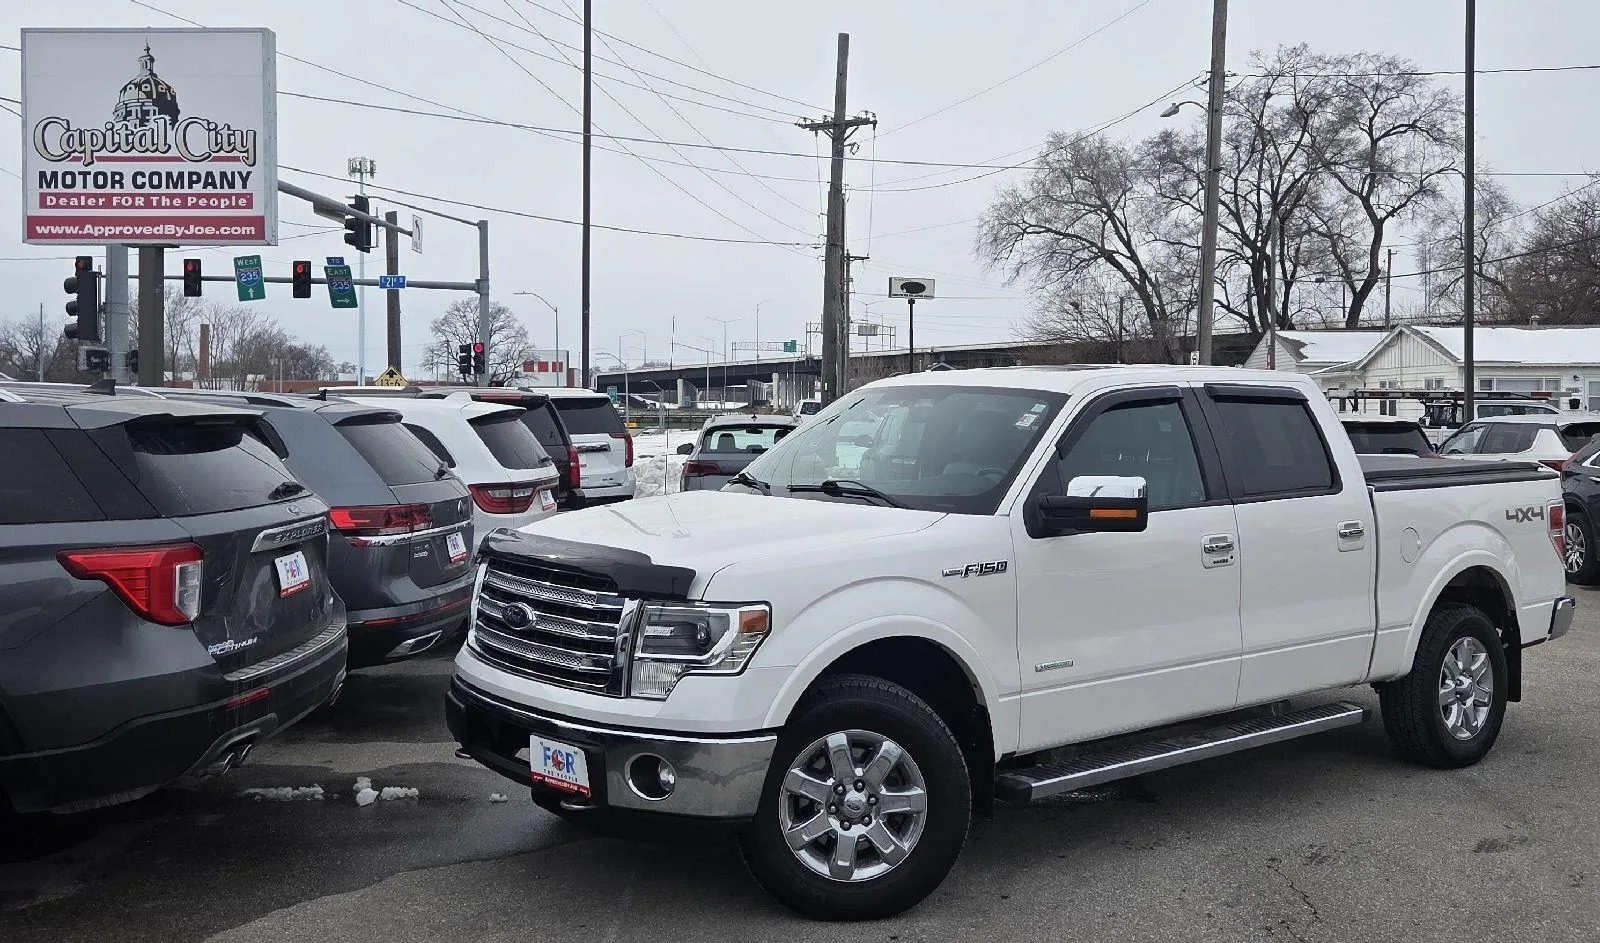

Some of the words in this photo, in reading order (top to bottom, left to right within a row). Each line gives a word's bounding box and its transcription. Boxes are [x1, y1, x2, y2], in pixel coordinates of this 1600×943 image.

[34, 116, 171, 167] Capital
[174, 116, 257, 167] City
[38, 170, 125, 190] MOTOR
[131, 170, 253, 190] COMPANY
[46, 195, 105, 207] Dealer
[112, 196, 145, 207] FOR
[150, 196, 182, 207] The
[187, 195, 248, 208] People
[35, 223, 256, 237] www.ApprovedByJoe.com
[236, 258, 258, 266] WEST
[240, 271, 259, 282] 235
[327, 268, 348, 276] EAST
[332, 281, 350, 290] 235
[273, 524, 323, 544] EXPLORER
[543, 746, 577, 775] FOR
